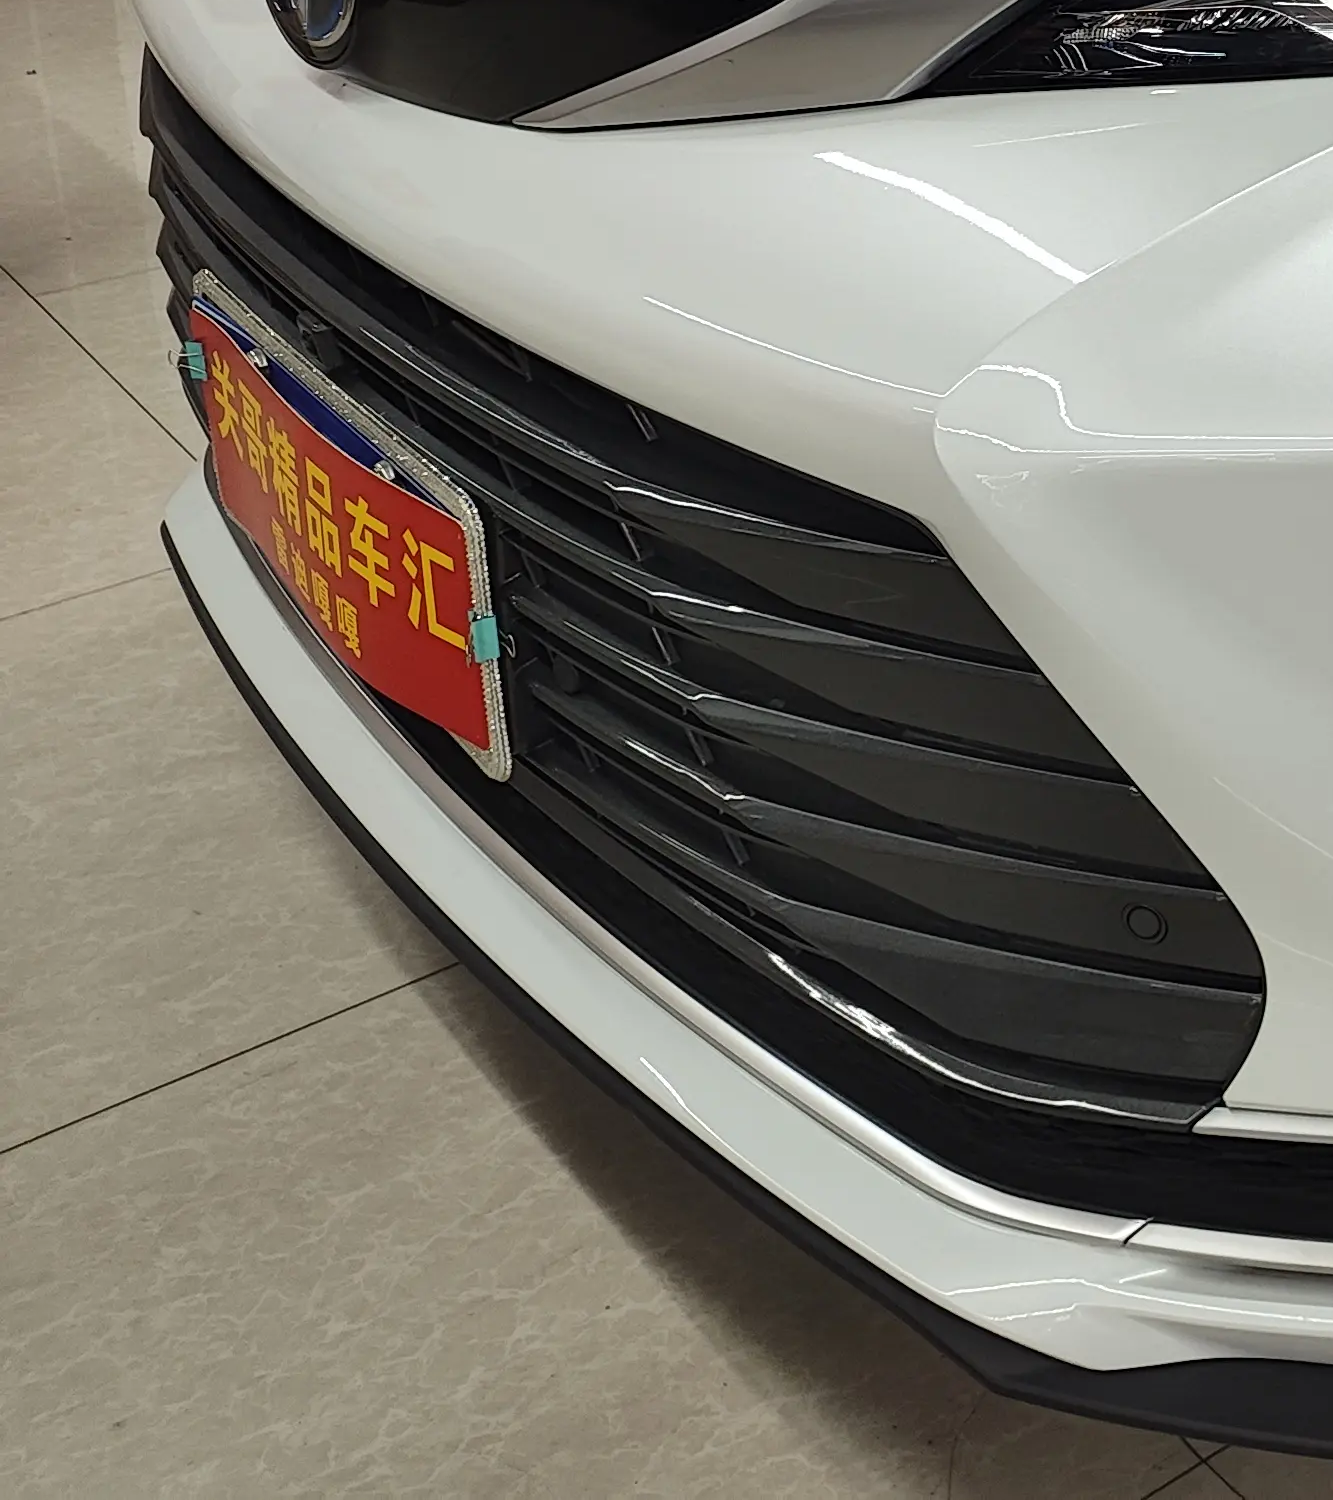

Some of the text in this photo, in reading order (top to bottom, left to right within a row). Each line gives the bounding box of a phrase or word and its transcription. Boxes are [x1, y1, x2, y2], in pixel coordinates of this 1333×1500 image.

[211, 349, 469, 651] 关哥精品车汇
